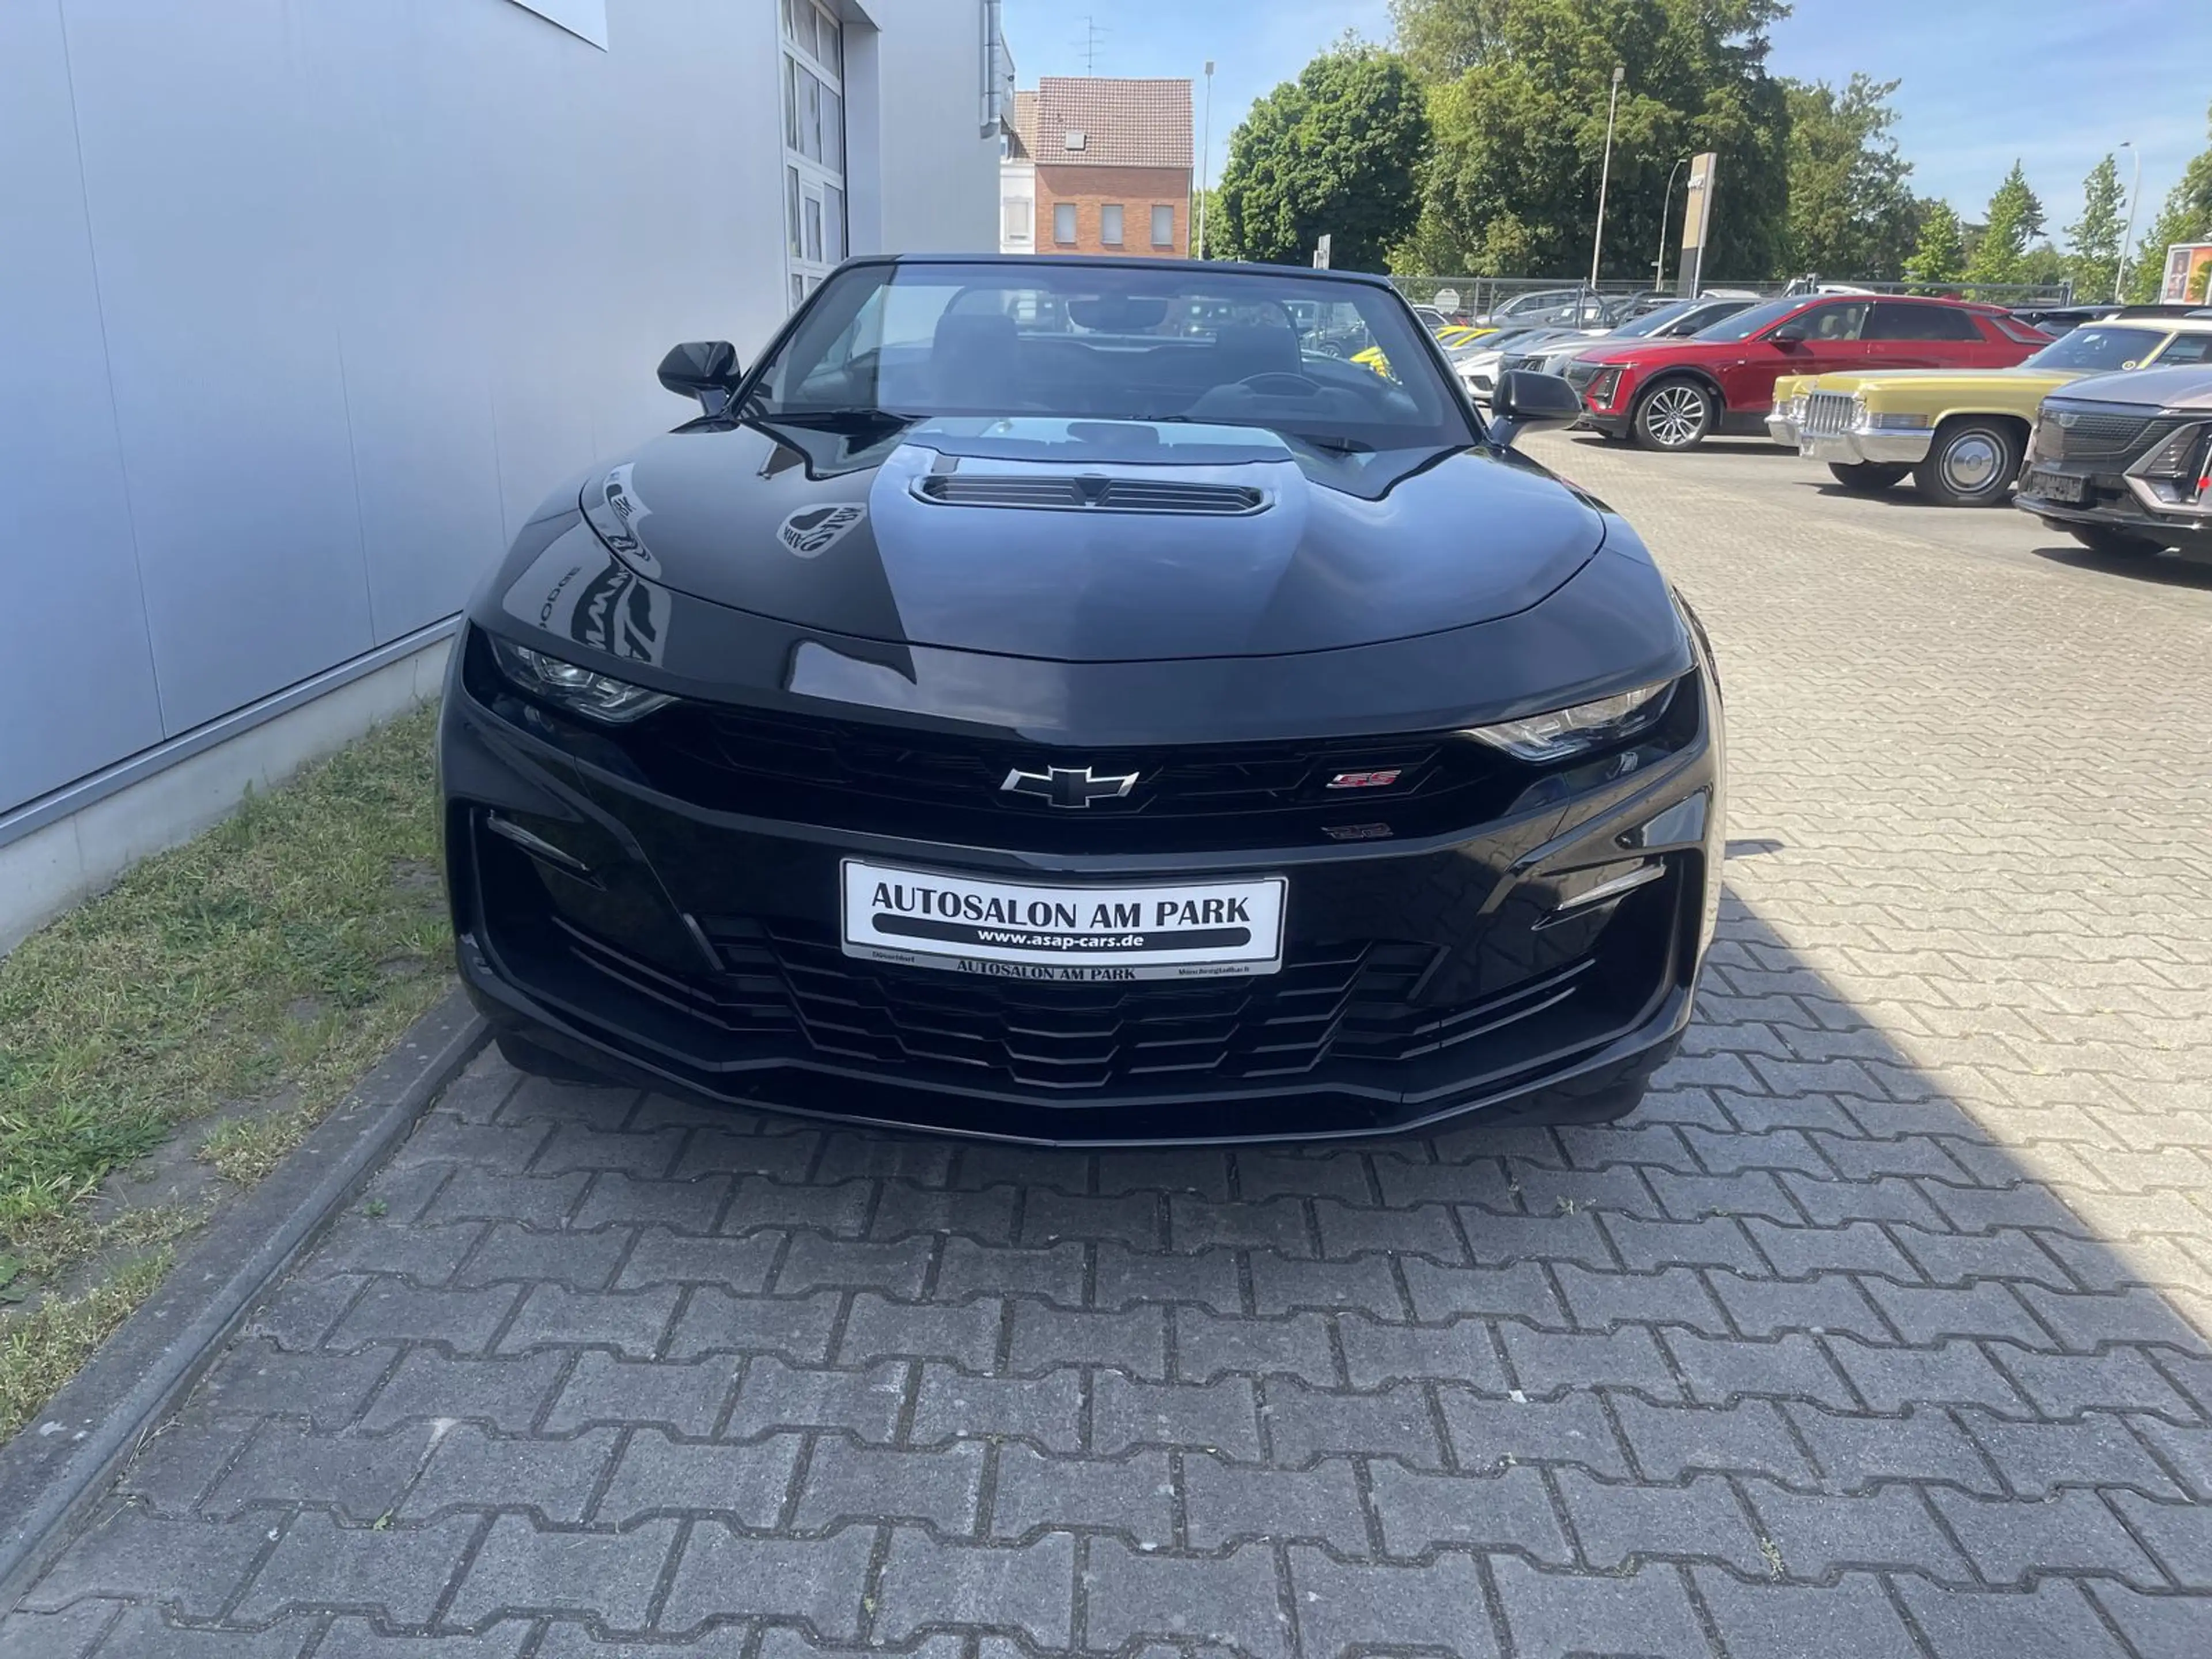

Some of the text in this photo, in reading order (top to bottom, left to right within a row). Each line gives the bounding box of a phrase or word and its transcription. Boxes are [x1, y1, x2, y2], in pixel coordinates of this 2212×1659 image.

[1325, 770, 1402, 789] SS
[872, 882, 1251, 929] AUTOSALON AM PARK
[978, 929, 1144, 949] www.asap-cars.de
[957, 960, 1135, 980] AUTOSALON AM PARK
